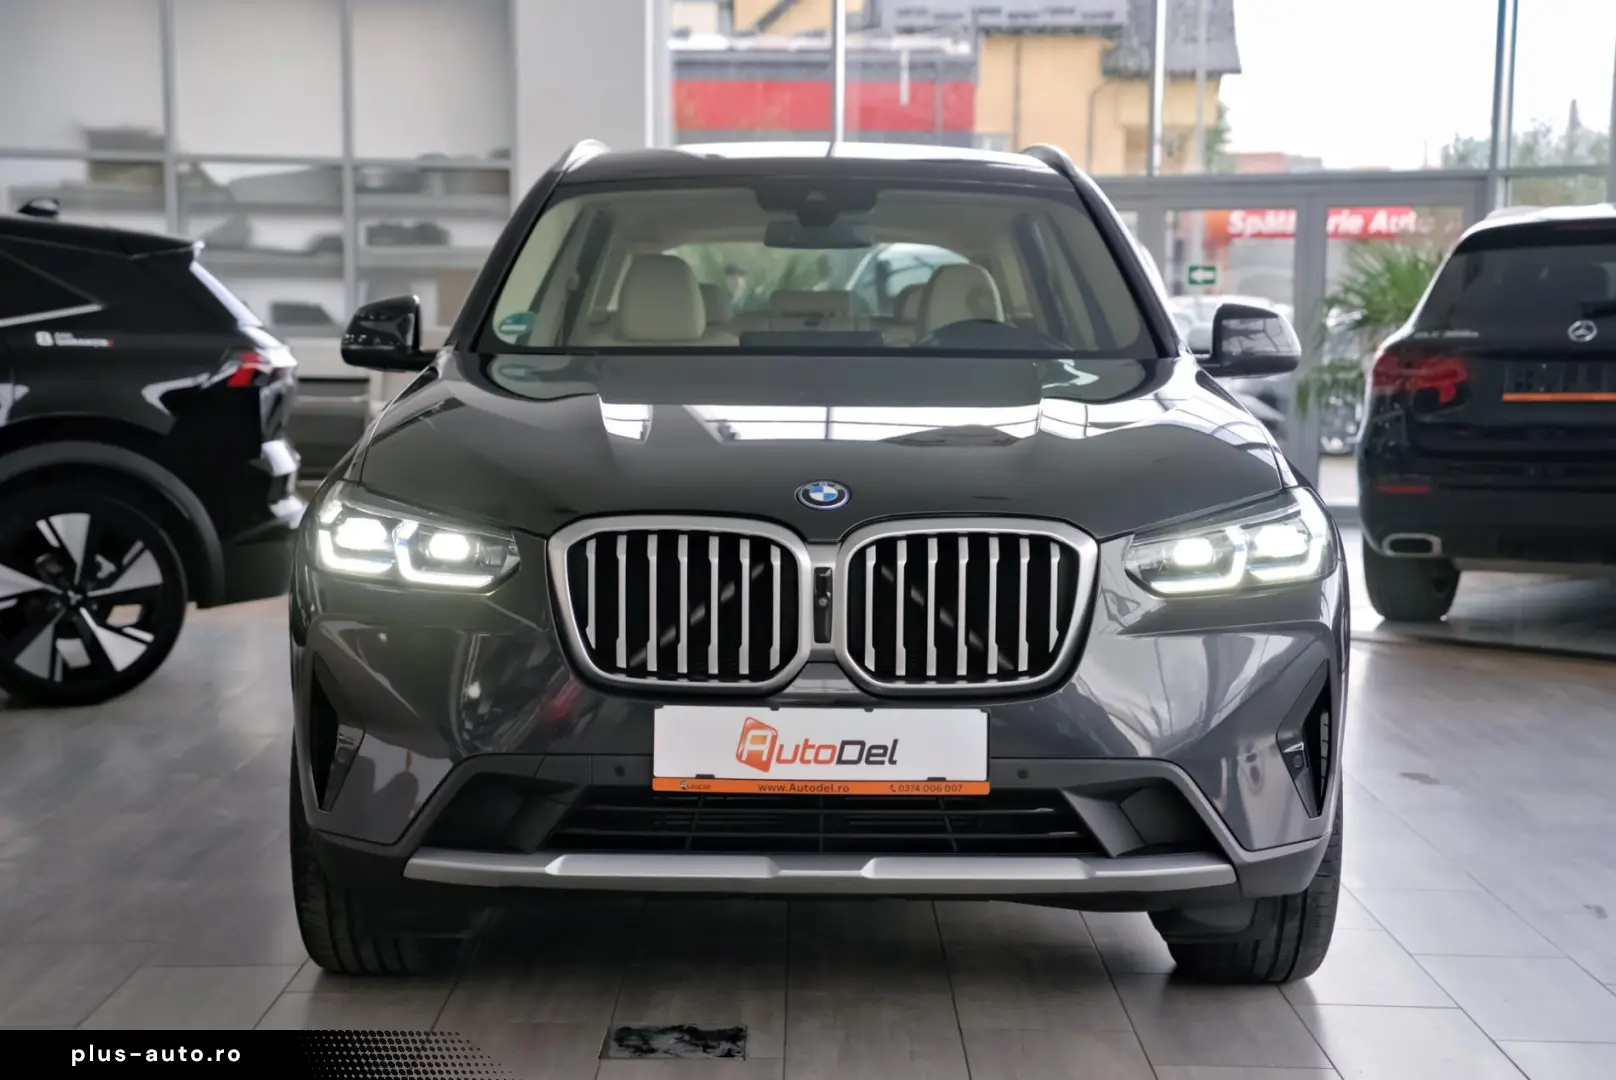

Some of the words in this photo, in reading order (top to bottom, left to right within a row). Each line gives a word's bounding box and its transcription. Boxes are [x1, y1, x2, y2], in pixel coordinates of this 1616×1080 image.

[738, 722, 899, 770] AutoDel
[758, 783, 850, 794] www.Autodel.ro
[898, 784, 921, 793] 0374
